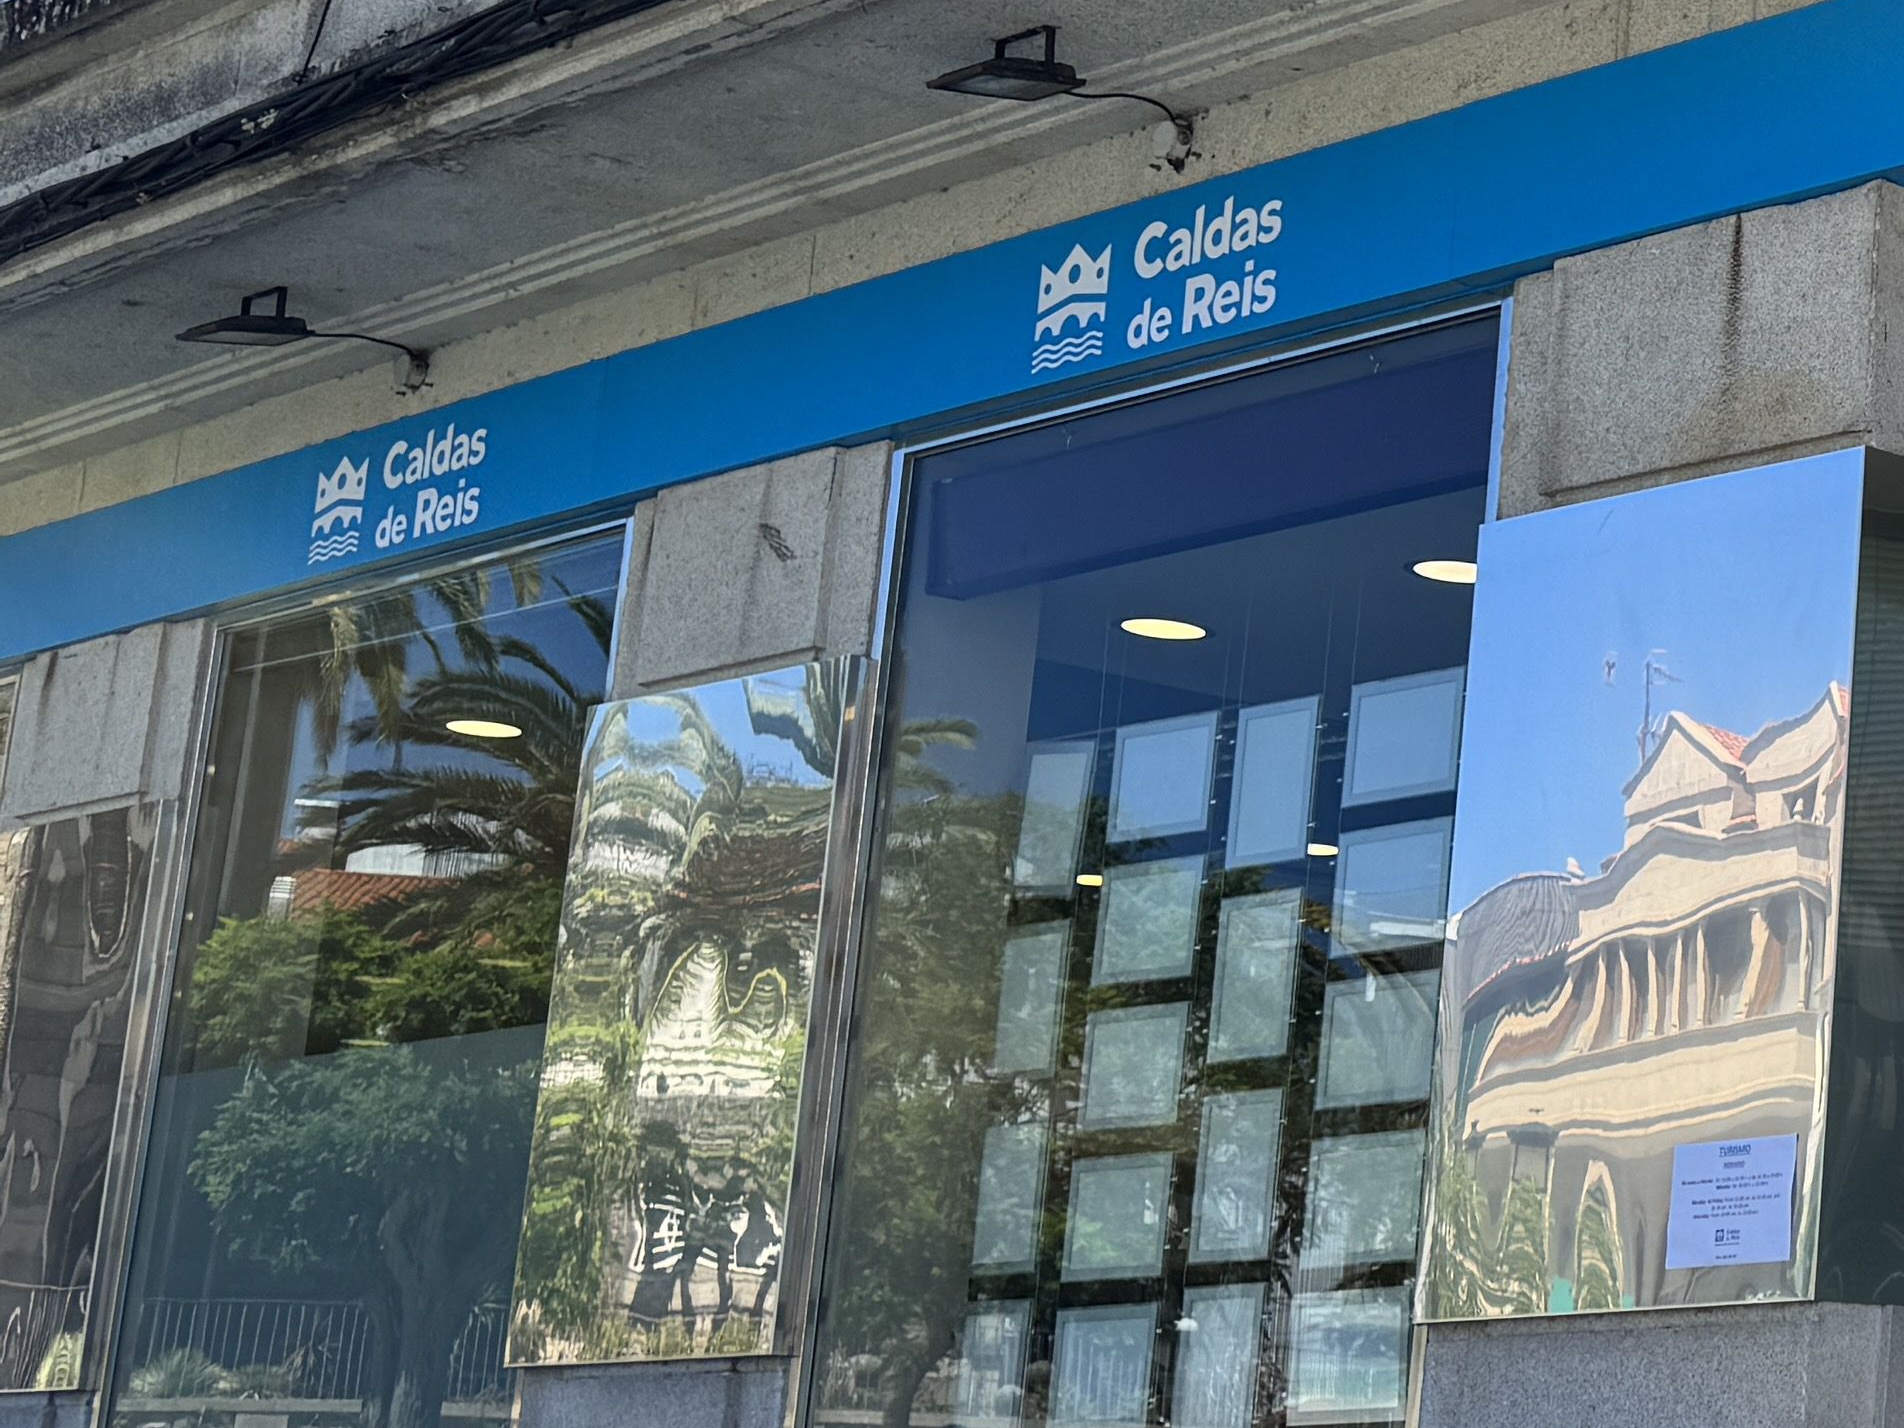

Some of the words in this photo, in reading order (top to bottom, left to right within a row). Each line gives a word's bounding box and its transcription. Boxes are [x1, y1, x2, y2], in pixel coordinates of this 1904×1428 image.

[1133, 195, 1283, 279] Caldas
[1126, 297, 1172, 349] de
[1182, 260, 1276, 334] Reis
[383, 422, 487, 490] Caldas
[376, 505, 407, 548] de
[412, 478, 480, 539] Reis
